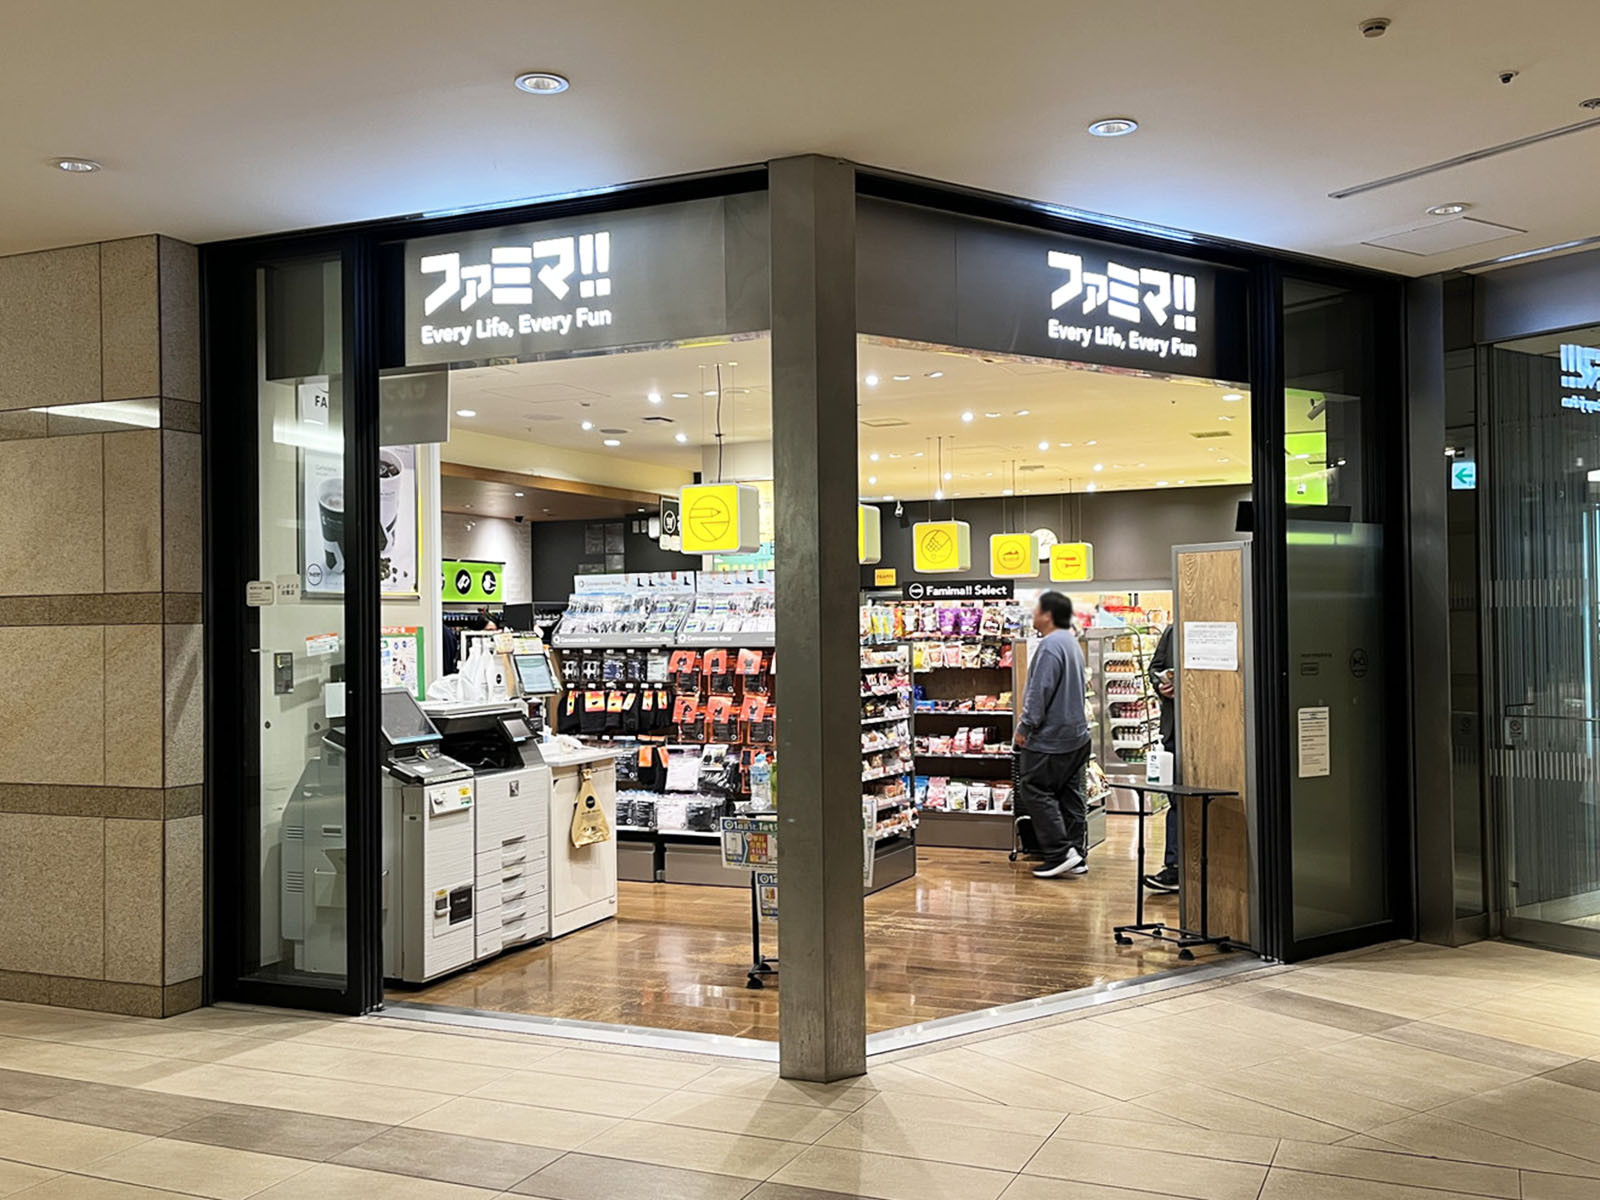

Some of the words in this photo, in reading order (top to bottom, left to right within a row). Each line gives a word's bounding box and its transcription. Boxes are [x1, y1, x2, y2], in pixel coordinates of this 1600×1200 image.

[421, 231, 611, 316] ファミマ!!
[1048, 250, 1197, 331] ファミマ!!
[421, 324, 472, 345] Every
[476, 318, 514, 339] Life,
[518, 313, 572, 335] Every
[576, 307, 611, 327] Fun
[1048, 318, 1092, 347] Every
[1095, 325, 1127, 350] Life,
[1129, 330, 1169, 358] Every
[1171, 337, 1197, 358] Fun
[926, 585, 973, 596] Famima!!
[974, 584, 1007, 595] Select
